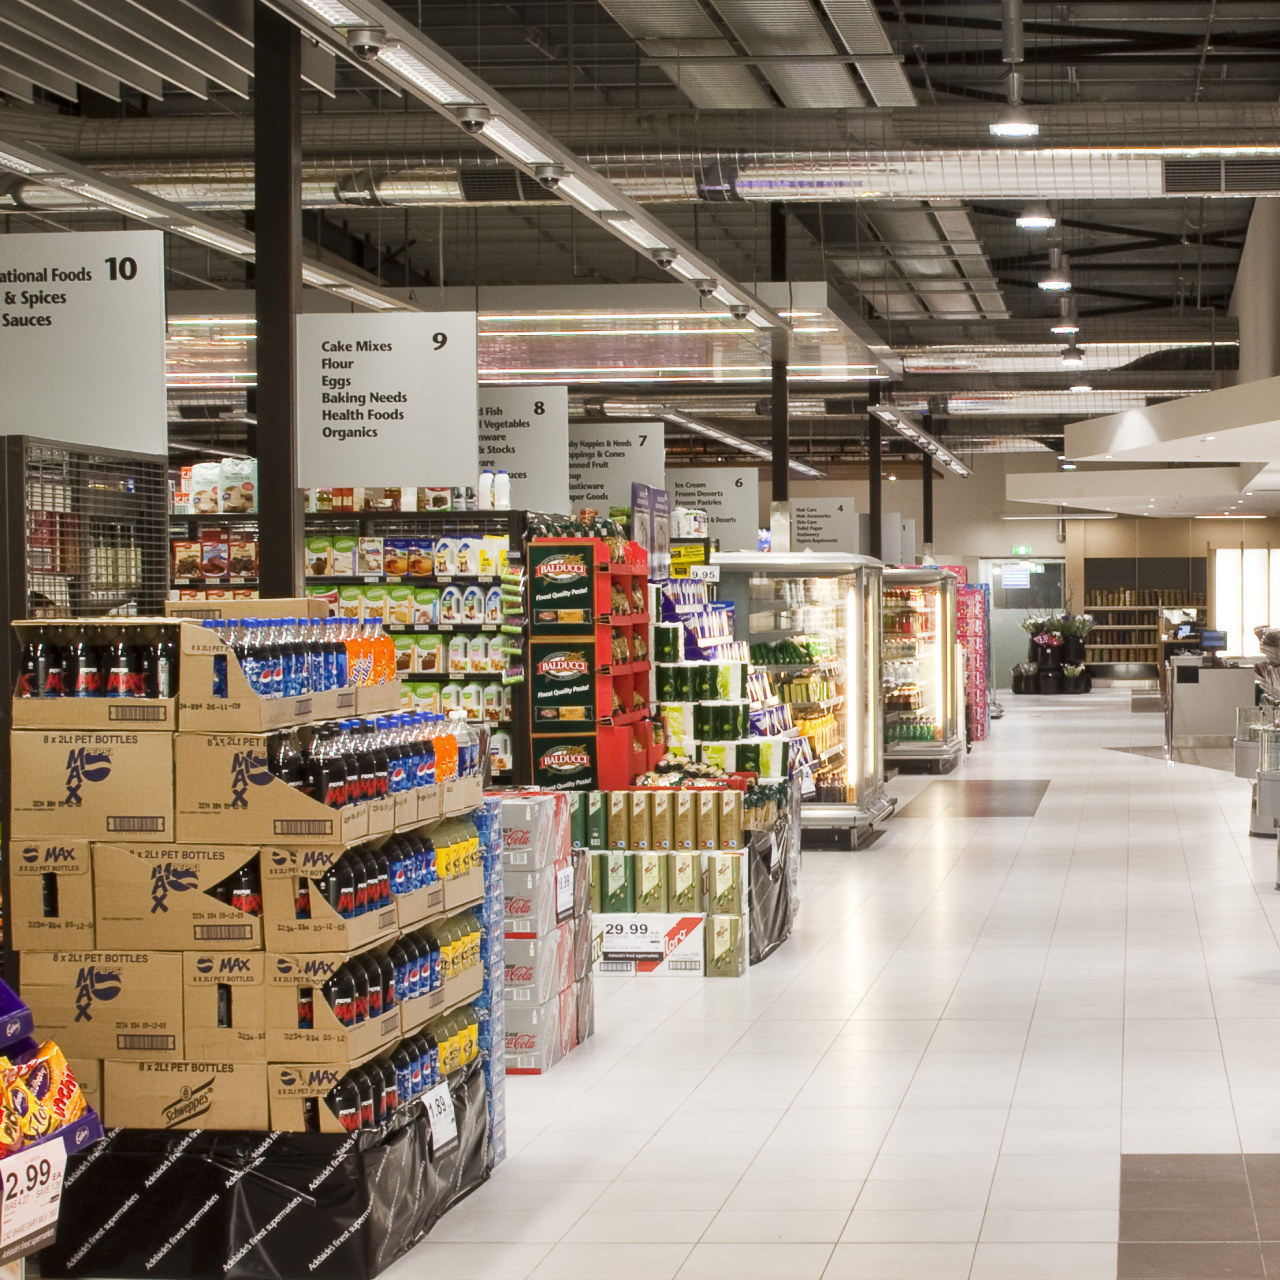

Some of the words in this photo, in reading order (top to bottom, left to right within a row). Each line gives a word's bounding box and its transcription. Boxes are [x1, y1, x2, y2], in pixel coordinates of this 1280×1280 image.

[52, 267, 92, 282] Foods
[104, 256, 138, 281] 10
[4, 291, 16, 305] &
[21, 290, 67, 309] Spices
[2, 313, 52, 327] Sauces
[321, 340, 353, 352] Cake
[356, 340, 393, 352] Mixes
[432, 332, 448, 351] 9
[321, 358, 354, 369] Flour
[321, 375, 351, 389] Eggs
[322, 392, 366, 406] Baking
[369, 391, 408, 403] Needs
[486, 407, 503, 416] Fish
[534, 401, 545, 415] 8
[322, 409, 364, 421] Health
[367, 409, 404, 420] Foods
[485, 420, 530, 431] Vegetables
[322, 426, 378, 441] Organics
[580, 440, 604, 449] Nappies
[639, 435, 648, 447] 7
[487, 445, 515, 454] Stocks
[592, 461, 609, 469] Fruit
[735, 477, 743, 487] 6
[586, 493, 608, 501] Goods
[540, 563, 585, 574] BALDUCCI
[536, 593, 551, 601] Finest
[551, 591, 572, 600] Quality
[542, 662, 585, 671] BALDUCCI
[553, 688, 573, 697] Quality
[43, 736, 49, 744] 8
[58, 735, 73, 744] 2Lt
[75, 735, 92, 744] PET
[95, 736, 138, 744] BOTTLES
[243, 738, 260, 746] PET
[544, 756, 587, 765] BALDUCCI
[45, 846, 76, 862] MAX
[144, 851, 158, 859] 2Lt
[161, 851, 179, 859] PET
[181, 851, 225, 860] BOTTLES
[302, 851, 334, 867] MAX
[605, 923, 648, 935] 29.99
[68, 954, 82, 962] 2Lt
[84, 954, 101, 962] PET
[105, 954, 148, 963] BOTTLES
[219, 957, 250, 973] MAX
[139, 1063, 144, 1071] 8
[154, 1063, 168, 1071] 2Lt
[171, 1063, 188, 1072] PET
[191, 1064, 234, 1072] BOTTLES
[165, 1092, 209, 1125] Schweppes
[428, 1094, 447, 1117] 1.89
[5, 1158, 51, 1201] 2.99
[185, 1193, 219, 1230] supermarkets
[265, 1196, 302, 1230] supermarkets
[332, 1230, 351, 1248] finest
